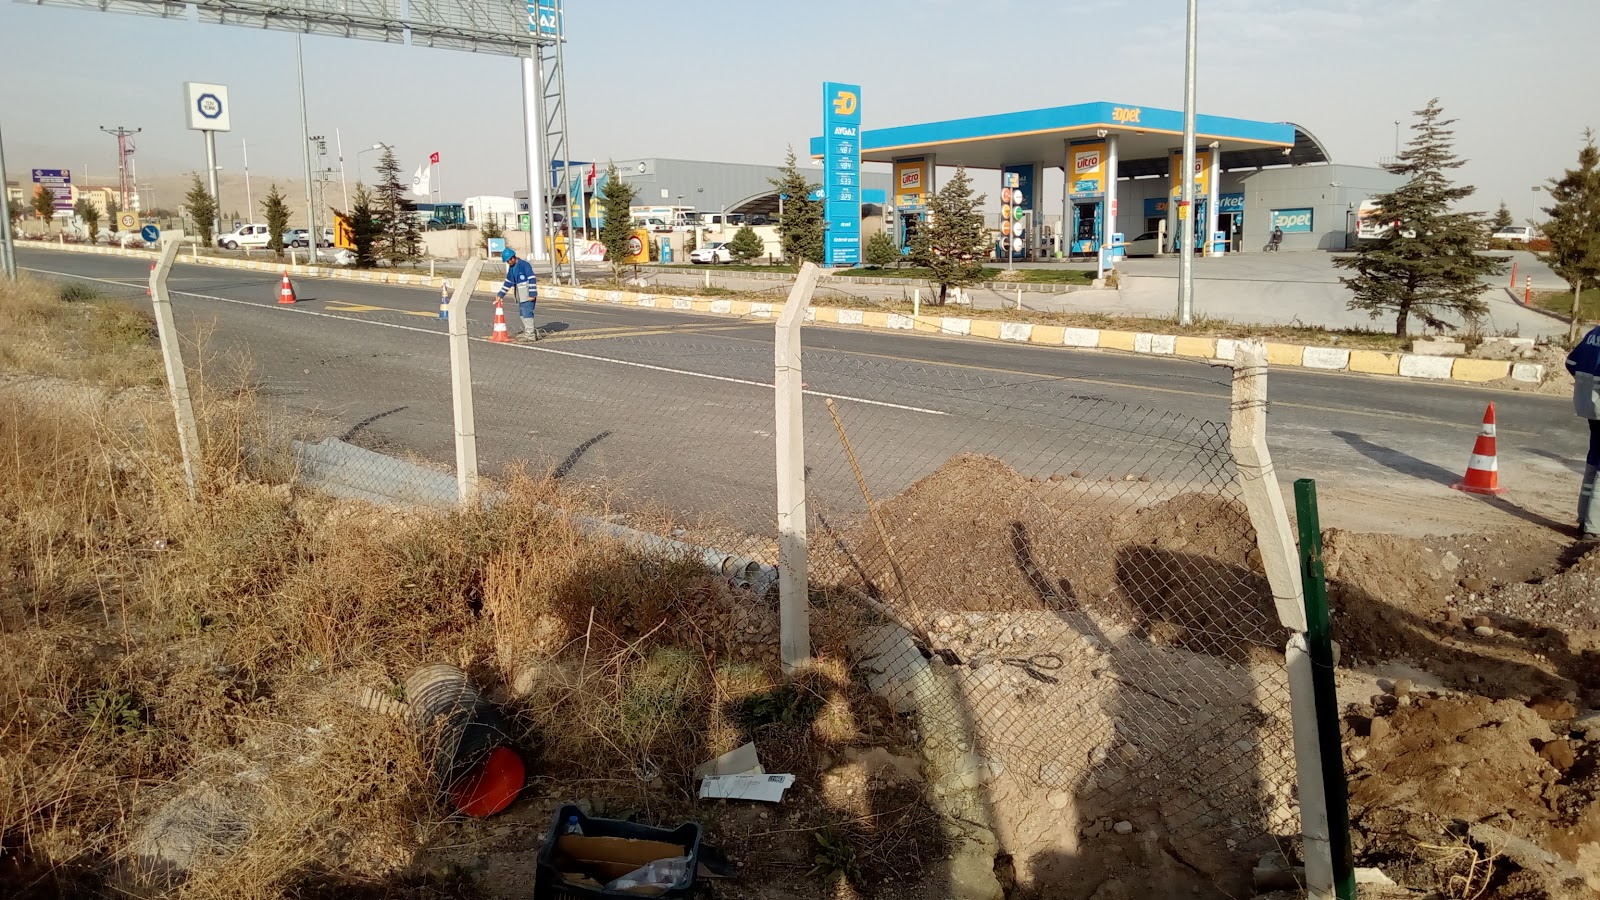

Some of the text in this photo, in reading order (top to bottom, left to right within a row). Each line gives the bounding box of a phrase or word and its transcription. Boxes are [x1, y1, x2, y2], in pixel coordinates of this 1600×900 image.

[834, 127, 857, 136] AYGAZ
[1077, 157, 1098, 169] ultra
[902, 173, 919, 184] ultra
[124, 217, 133, 225] 50
